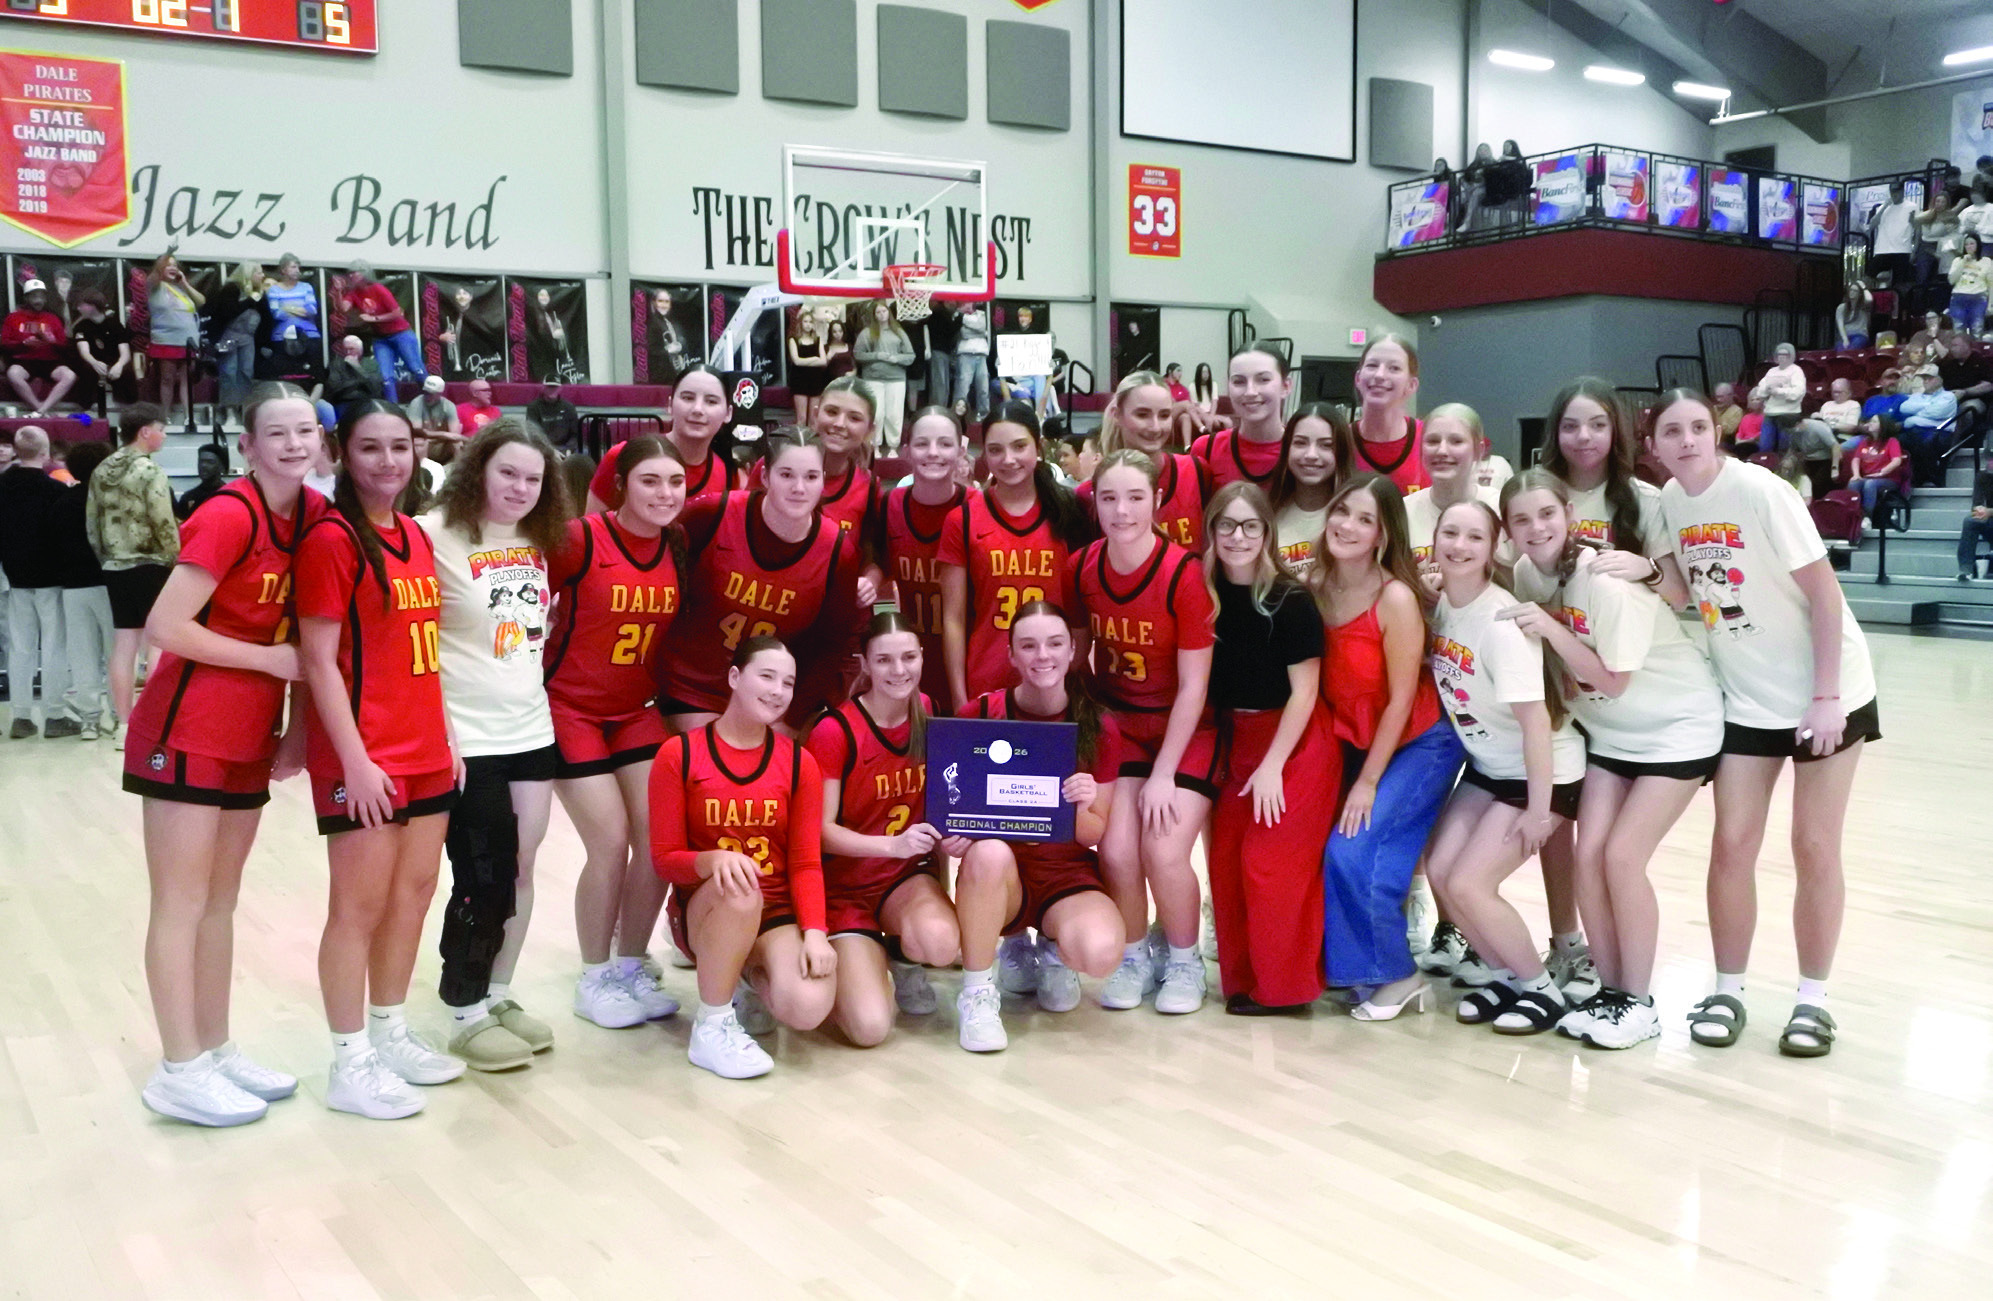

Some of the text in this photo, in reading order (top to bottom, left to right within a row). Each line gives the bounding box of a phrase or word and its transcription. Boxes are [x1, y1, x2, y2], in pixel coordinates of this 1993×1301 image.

[35, 64, 79, 82] DALE
[23, 83, 93, 103] PIRATES
[29, 108, 85, 127] STATE
[12, 124, 106, 146] CHAMPION
[24, 145, 97, 163] JAZZ BAND
[17, 167, 46, 183] 2003
[18, 183, 47, 198] 2018
[19, 199, 48, 214] 2019
[118, 164, 508, 250] Jazz Band
[1133, 194, 1176, 237] 33
[692, 186, 775, 270] THE
[945, 205, 1032, 283] NEST
[1679, 522, 1745, 555] PIRATE
[467, 545, 546, 581] PIRATE
[989, 548, 1055, 577] DALE
[1687, 547, 1732, 564] PLAYOFFS
[489, 568, 541, 586] PLAYOFFS
[392, 575, 440, 611] DALE
[610, 584, 676, 614] DALE
[723, 571, 796, 616] DALE
[1090, 612, 1154, 646] DALE
[409, 619, 439, 676] 10
[610, 623, 657, 665] 21
[973, 746, 1029, 756] 20 26
[999, 788, 1048, 797] BASKETBALL
[704, 798, 779, 828] DALE
[885, 804, 911, 837] 2
[945, 818, 1053, 833] REGIONAL CHAMPION
